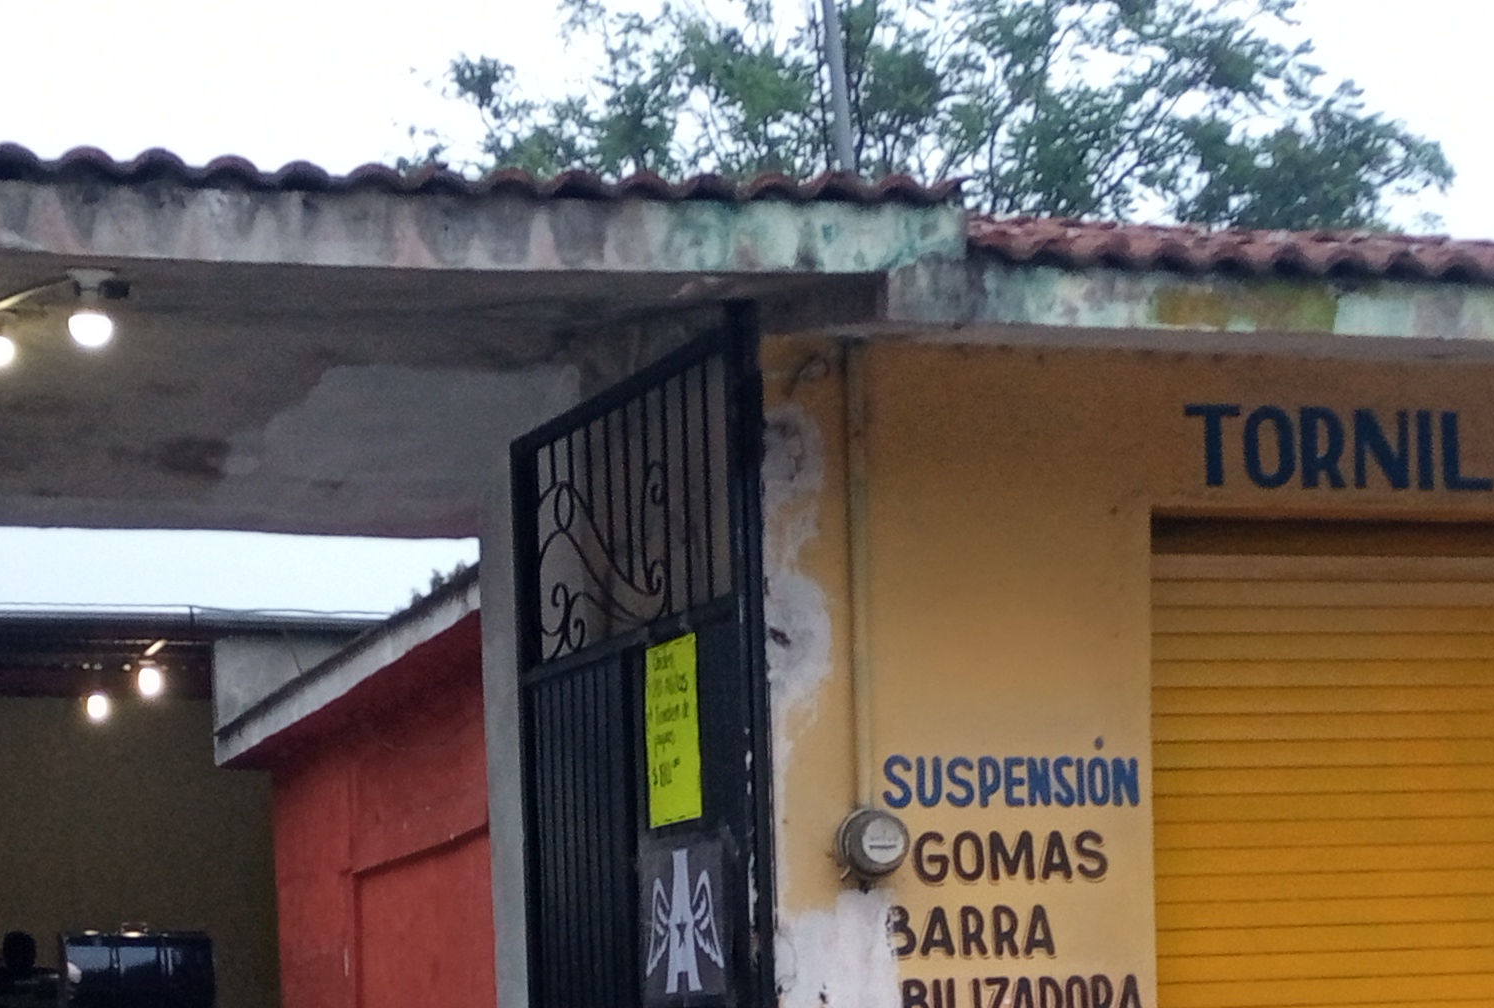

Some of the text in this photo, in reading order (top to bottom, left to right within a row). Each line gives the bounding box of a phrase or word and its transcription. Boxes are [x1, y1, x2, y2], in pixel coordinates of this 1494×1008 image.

[883, 736, 1140, 808] SUSPENSIÓN
[913, 830, 1108, 883] GOMAS
[886, 904, 1056, 957] BARRA
